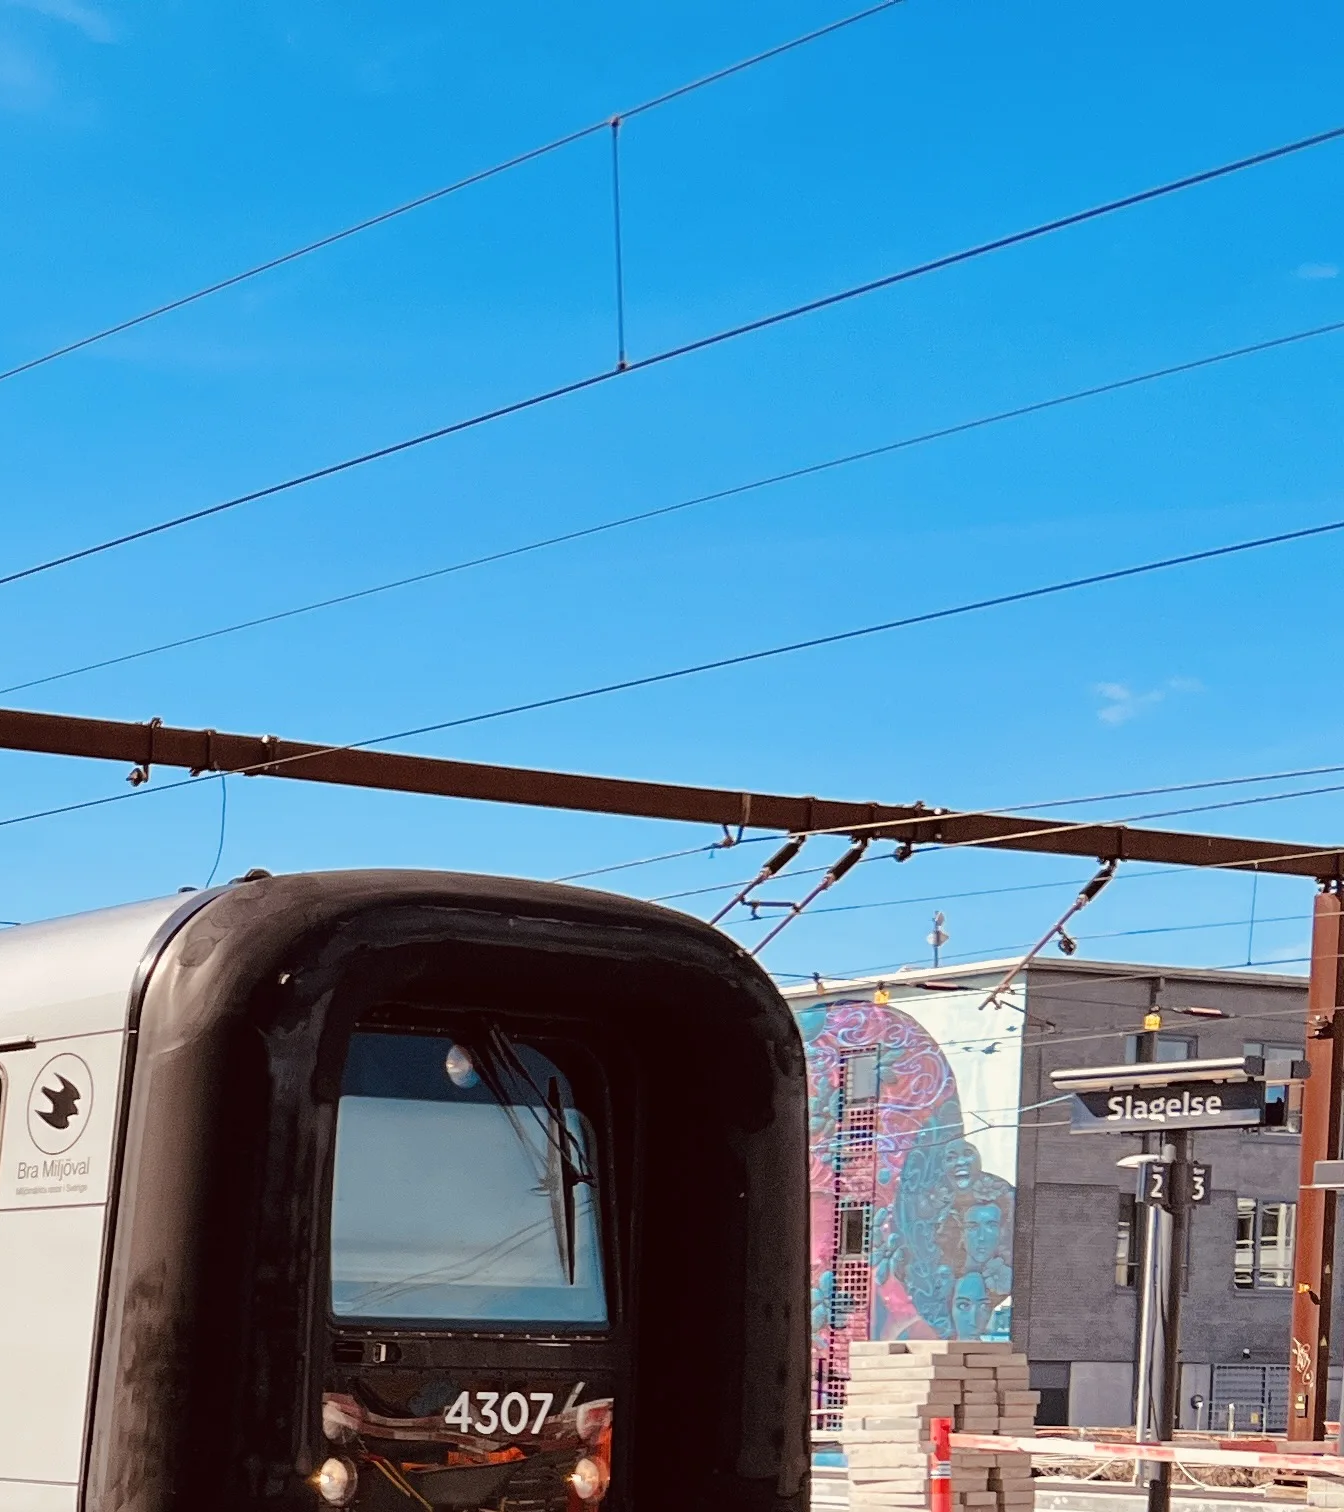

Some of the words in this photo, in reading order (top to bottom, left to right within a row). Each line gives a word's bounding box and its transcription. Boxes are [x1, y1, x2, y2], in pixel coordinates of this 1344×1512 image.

[1107, 1091, 1222, 1122] Slagelse
[17, 1161, 39, 1180] Bra
[42, 1156, 91, 1181] Miljöval
[1150, 1173, 1164, 1198] 2
[1192, 1176, 1205, 1201] 3
[444, 1390, 554, 1435] 4307
